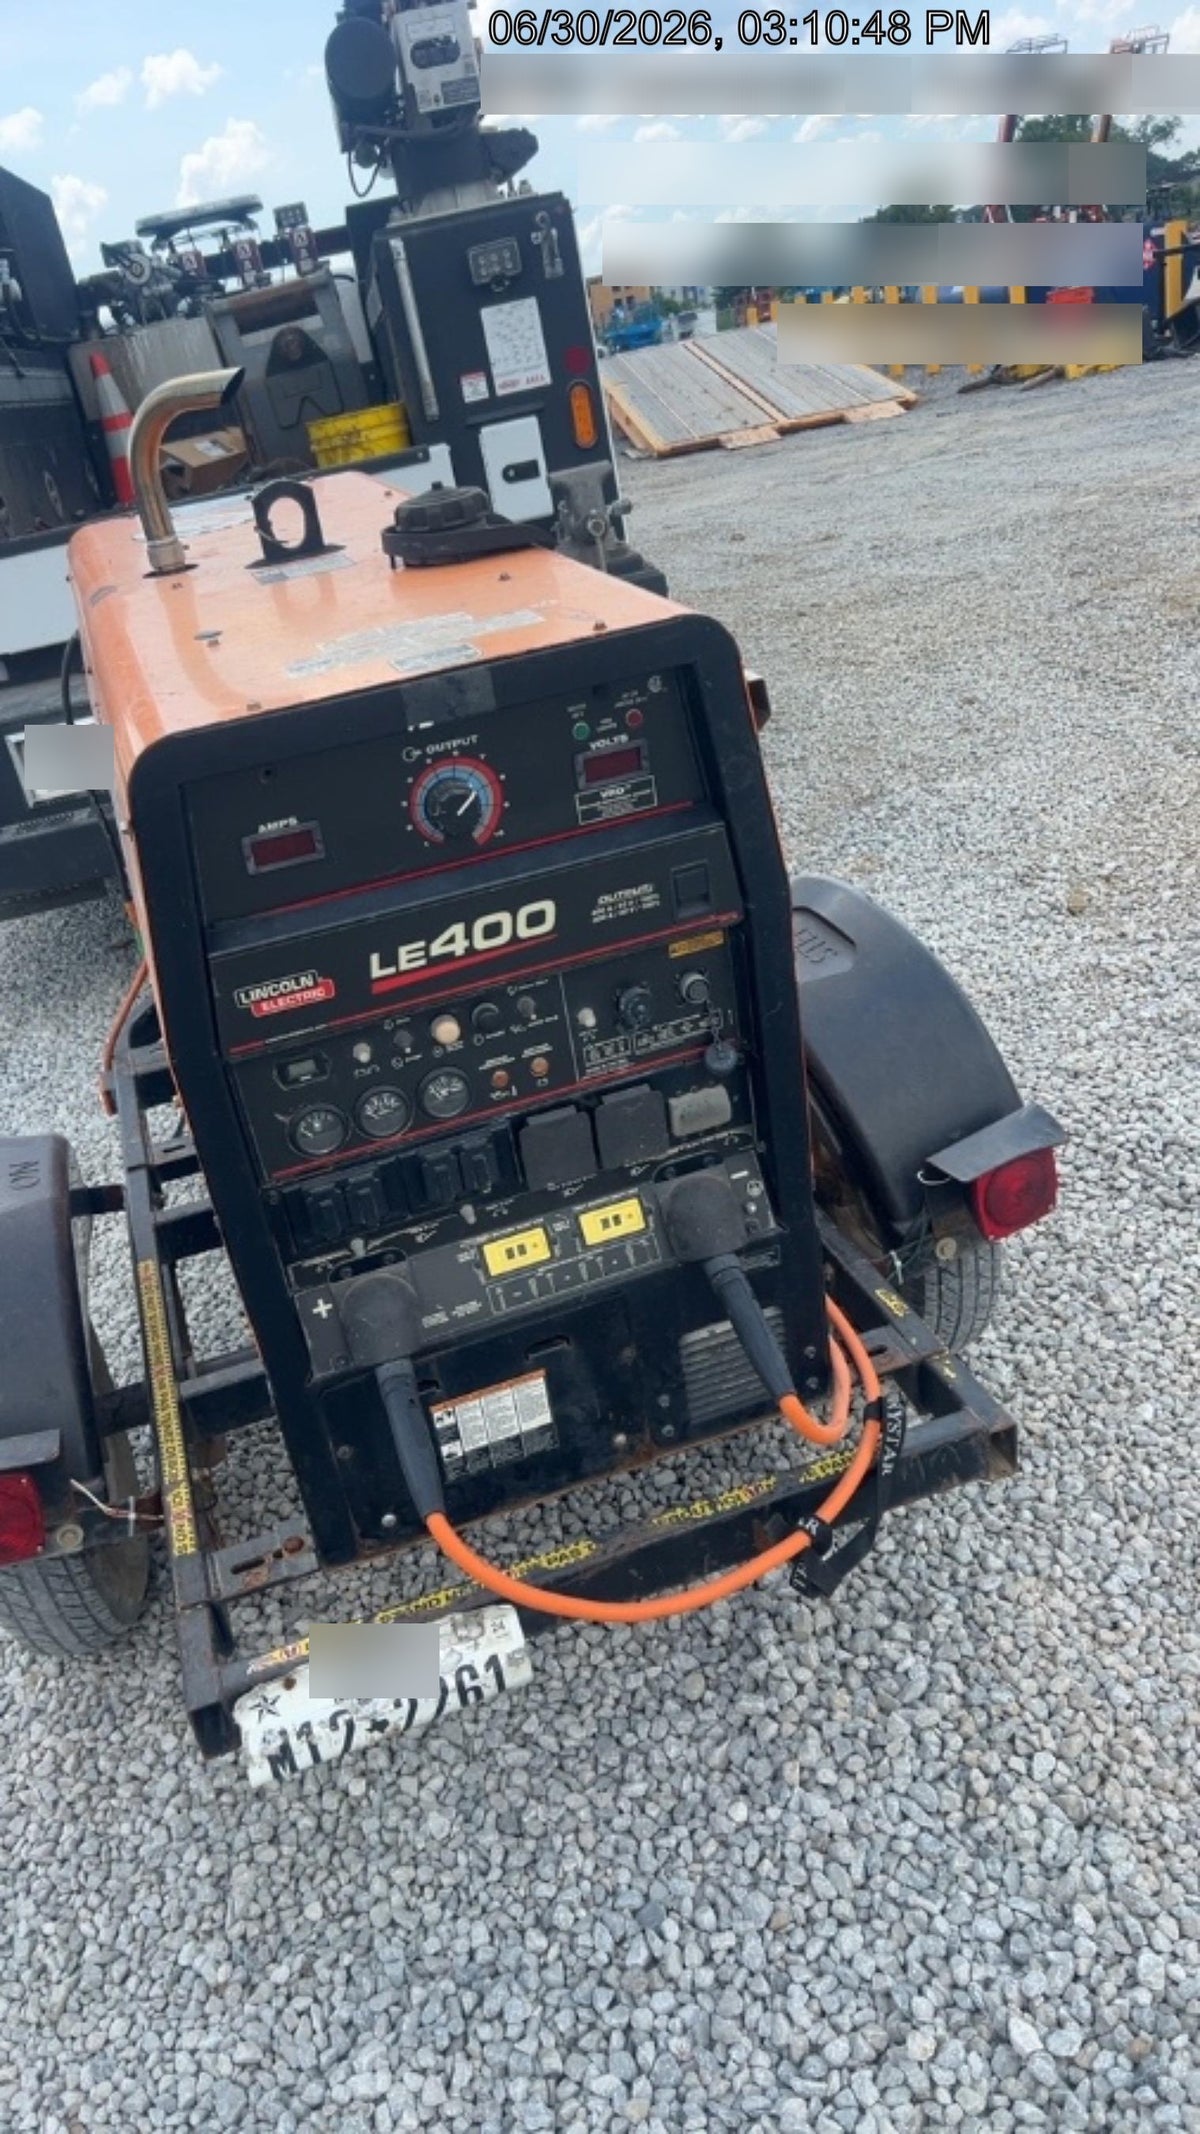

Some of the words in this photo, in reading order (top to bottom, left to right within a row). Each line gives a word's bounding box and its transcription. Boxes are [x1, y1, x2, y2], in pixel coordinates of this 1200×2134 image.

[426, 735, 478, 755] OUTPUT
[590, 734, 629, 750] VOLTS
[257, 816, 298, 834] AMPS
[369, 898, 556, 980] LE400
[240, 974, 314, 1004] LINCOLN
[261, 986, 326, 1012] ELECTRIC
